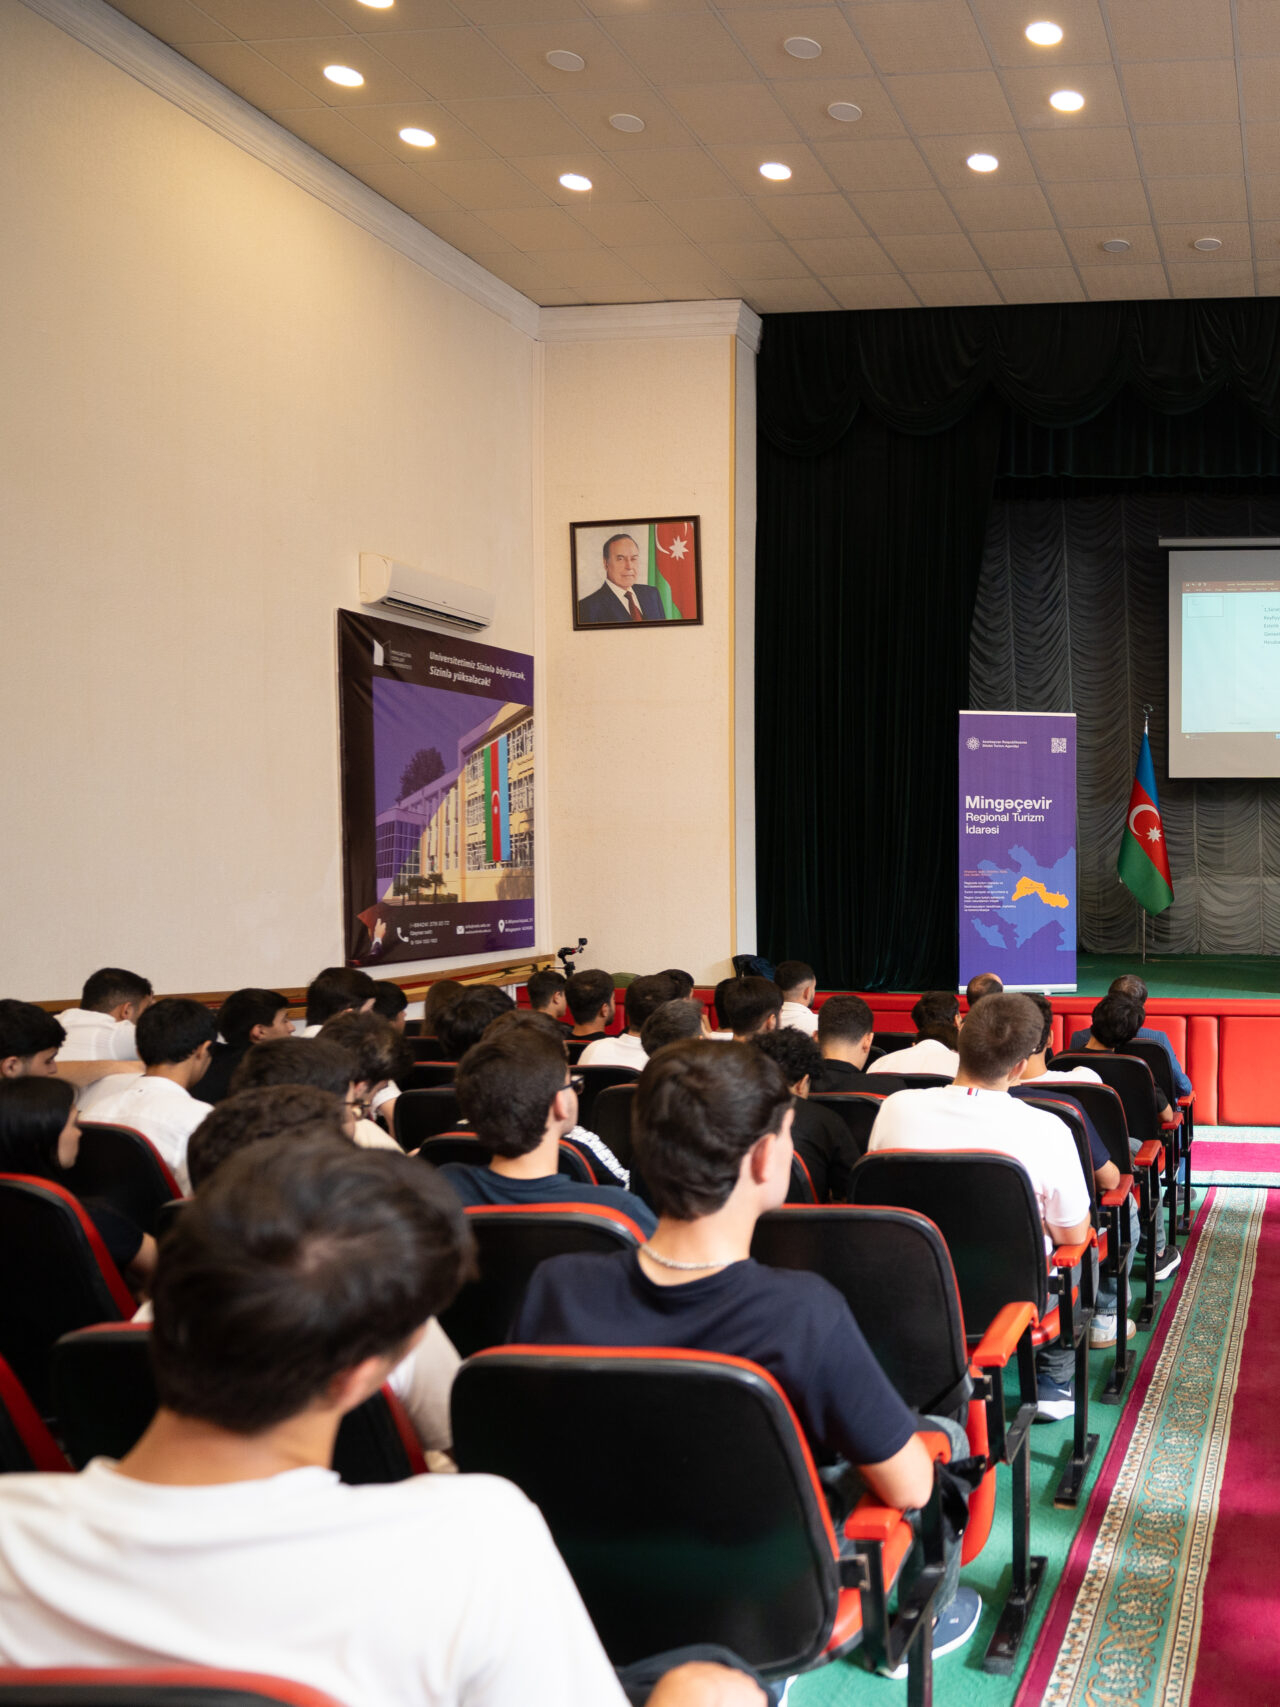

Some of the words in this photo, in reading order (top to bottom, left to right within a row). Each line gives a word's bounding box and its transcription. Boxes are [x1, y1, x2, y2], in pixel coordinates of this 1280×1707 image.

[429, 651, 476, 669] Universitetimiz
[429, 665, 452, 679] Sizinlə
[965, 795, 1053, 813] Mingəçevir
[965, 812, 1009, 824] Regional
[1012, 812, 1045, 822] Turizm
[965, 823, 1000, 834] İdarəsi
